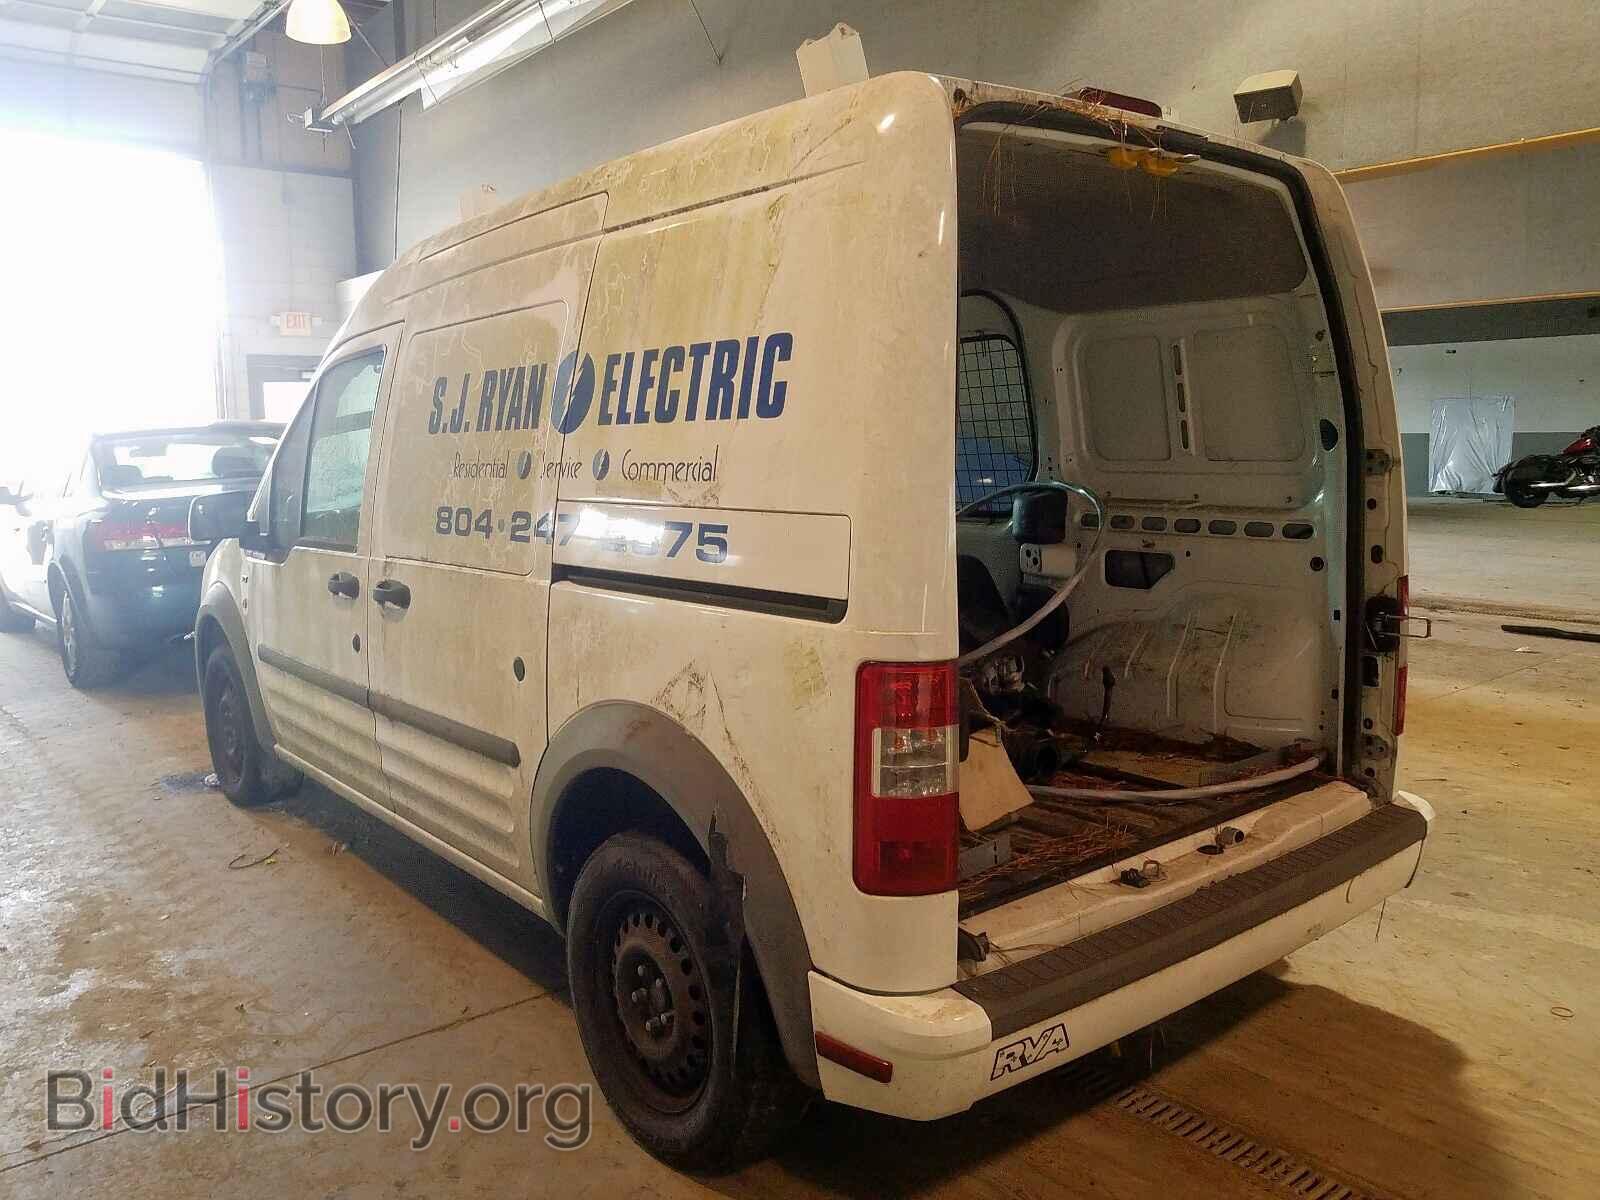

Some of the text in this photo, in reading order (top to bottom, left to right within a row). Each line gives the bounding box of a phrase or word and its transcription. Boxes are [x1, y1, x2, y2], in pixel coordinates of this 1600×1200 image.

[286, 313, 305, 329] EXIT
[428, 332, 793, 435] S.J. RYAN ELECTRIC
[453, 451, 510, 480] Residential
[621, 444, 720, 482] Commercial
[990, 1023, 1070, 1081] RVA
